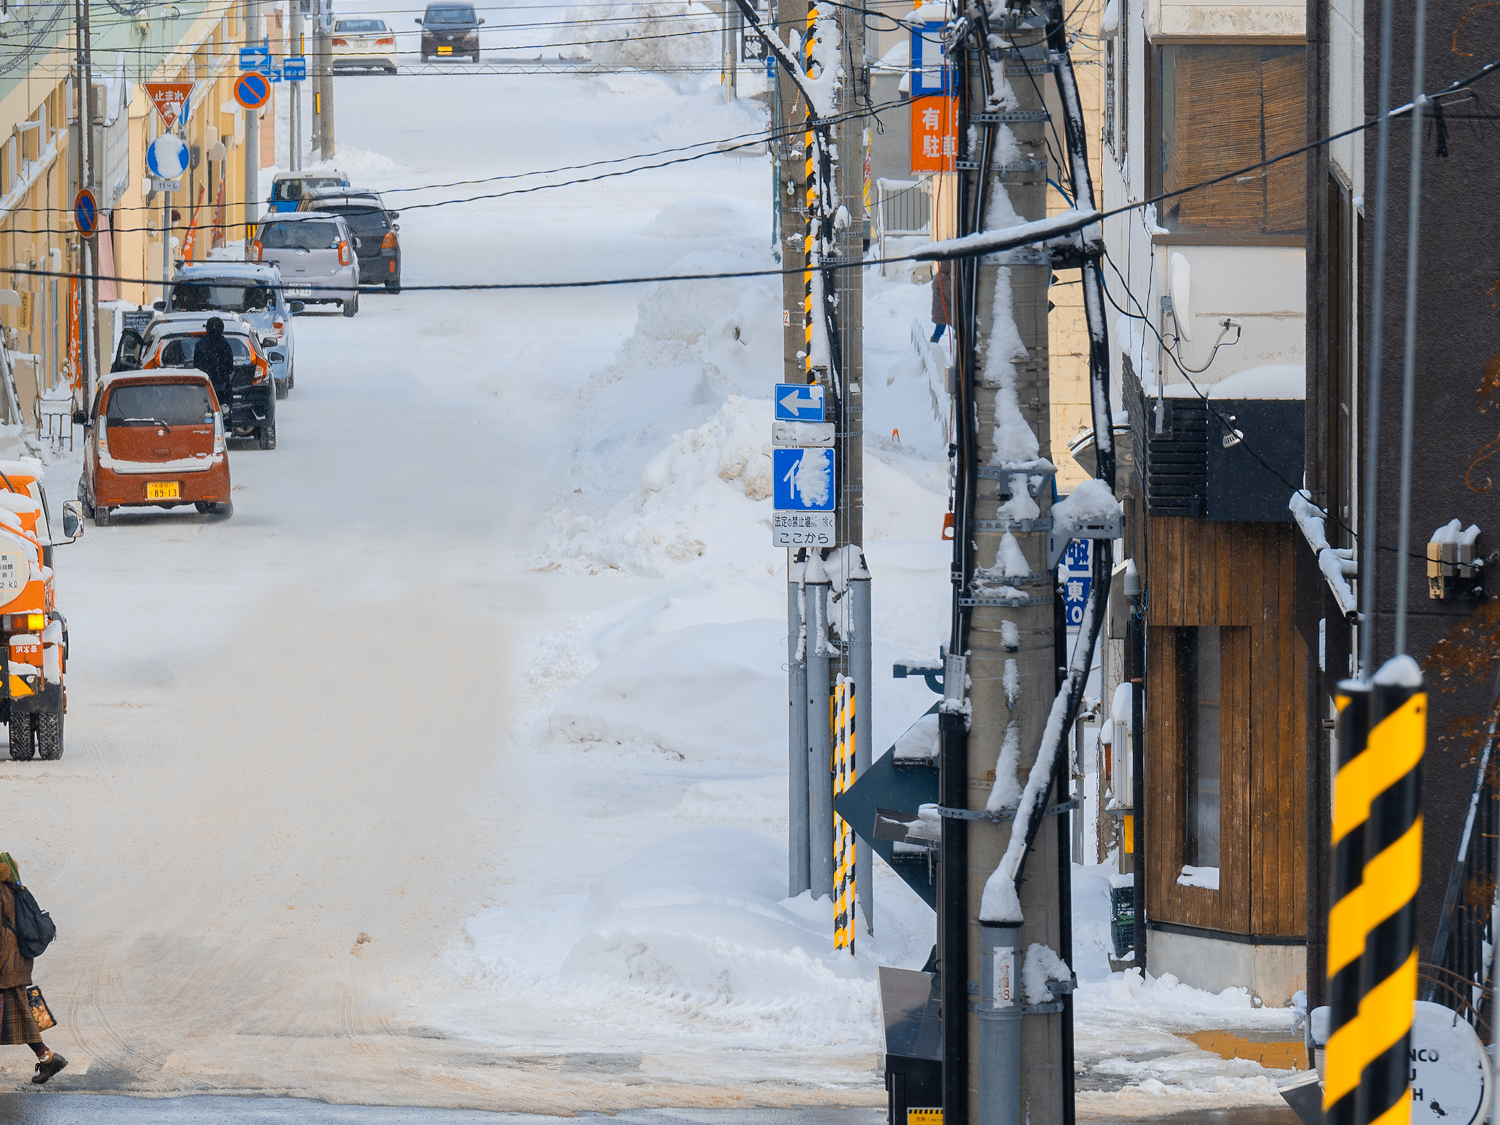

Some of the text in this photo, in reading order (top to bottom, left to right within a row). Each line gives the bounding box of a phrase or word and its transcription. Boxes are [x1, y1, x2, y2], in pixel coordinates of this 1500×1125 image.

[154, 90, 185, 102] 止まれ
[779, 531, 830, 544] ここから
[1066, 580, 1085, 603] 東
